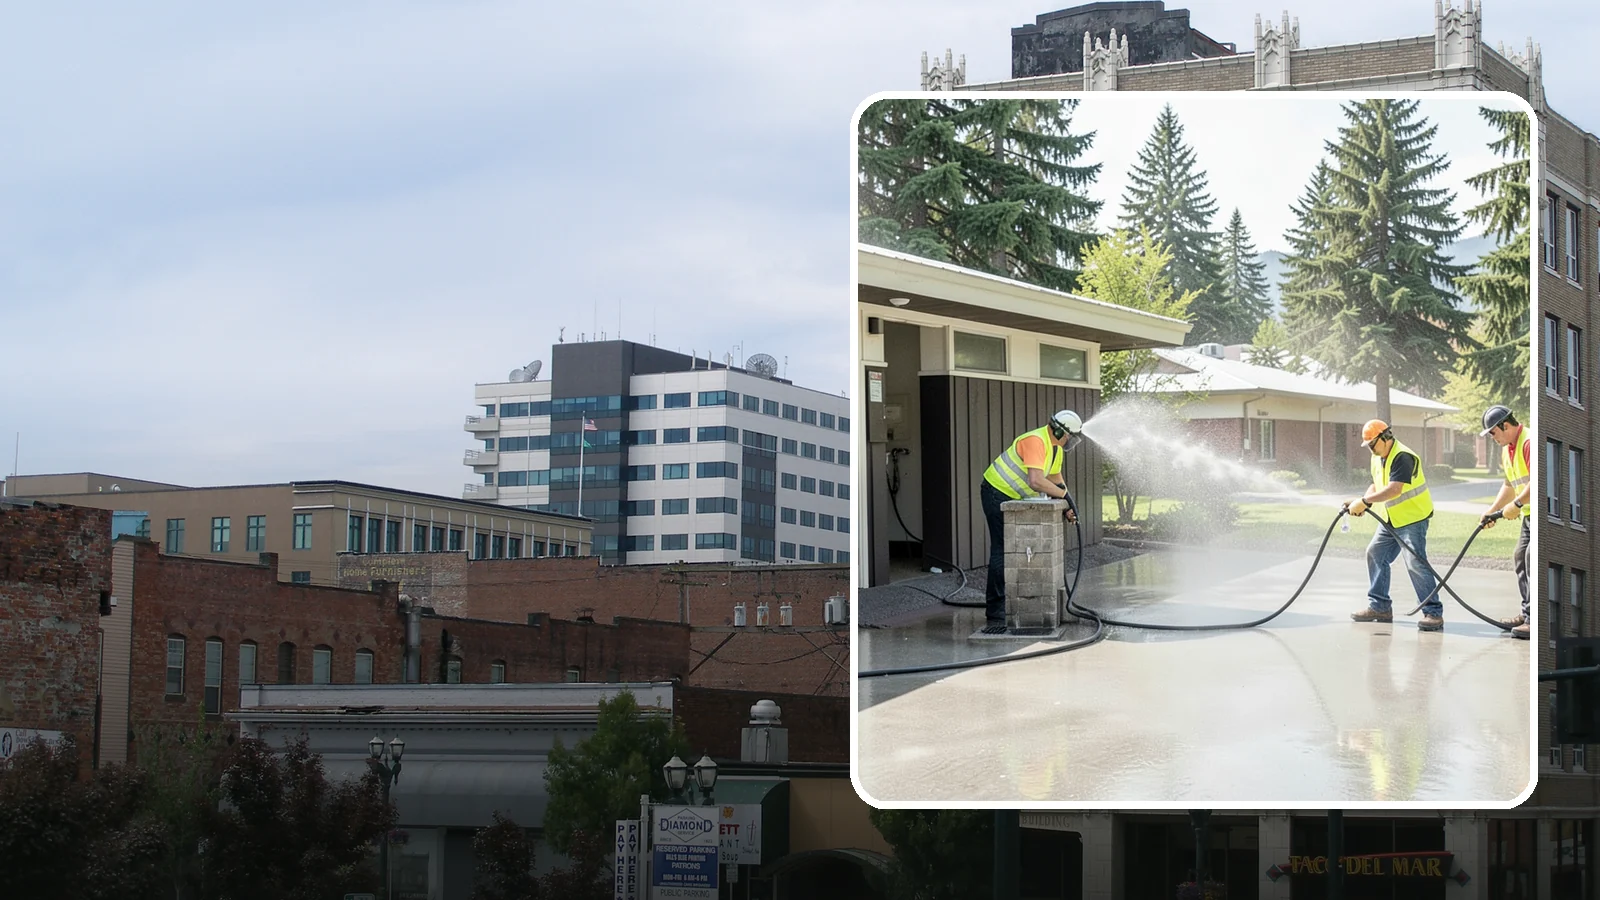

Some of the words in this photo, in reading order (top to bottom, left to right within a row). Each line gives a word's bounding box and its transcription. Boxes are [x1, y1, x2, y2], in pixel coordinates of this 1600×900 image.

[370, 566, 427, 576] Furnishers
[660, 818, 713, 833] DIAMOND
[1022, 815, 1070, 828] BUILDING
[719, 823, 740, 835] ETT
[617, 825, 625, 852] PAY
[628, 824, 637, 852] PAY
[719, 839, 740, 849] ANT
[656, 845, 688, 853] RESERVED
[689, 846, 716, 854] PARKING
[721, 851, 739, 862] Soup
[671, 861, 701, 870] PATRONS
[1345, 856, 1385, 876] DEL
[1391, 857, 1443, 877] MAR
[616, 856, 625, 893] HERE
[627, 855, 636, 893] HERE
[660, 888, 682, 897] PUBLIC
[684, 889, 710, 898] PARKING
